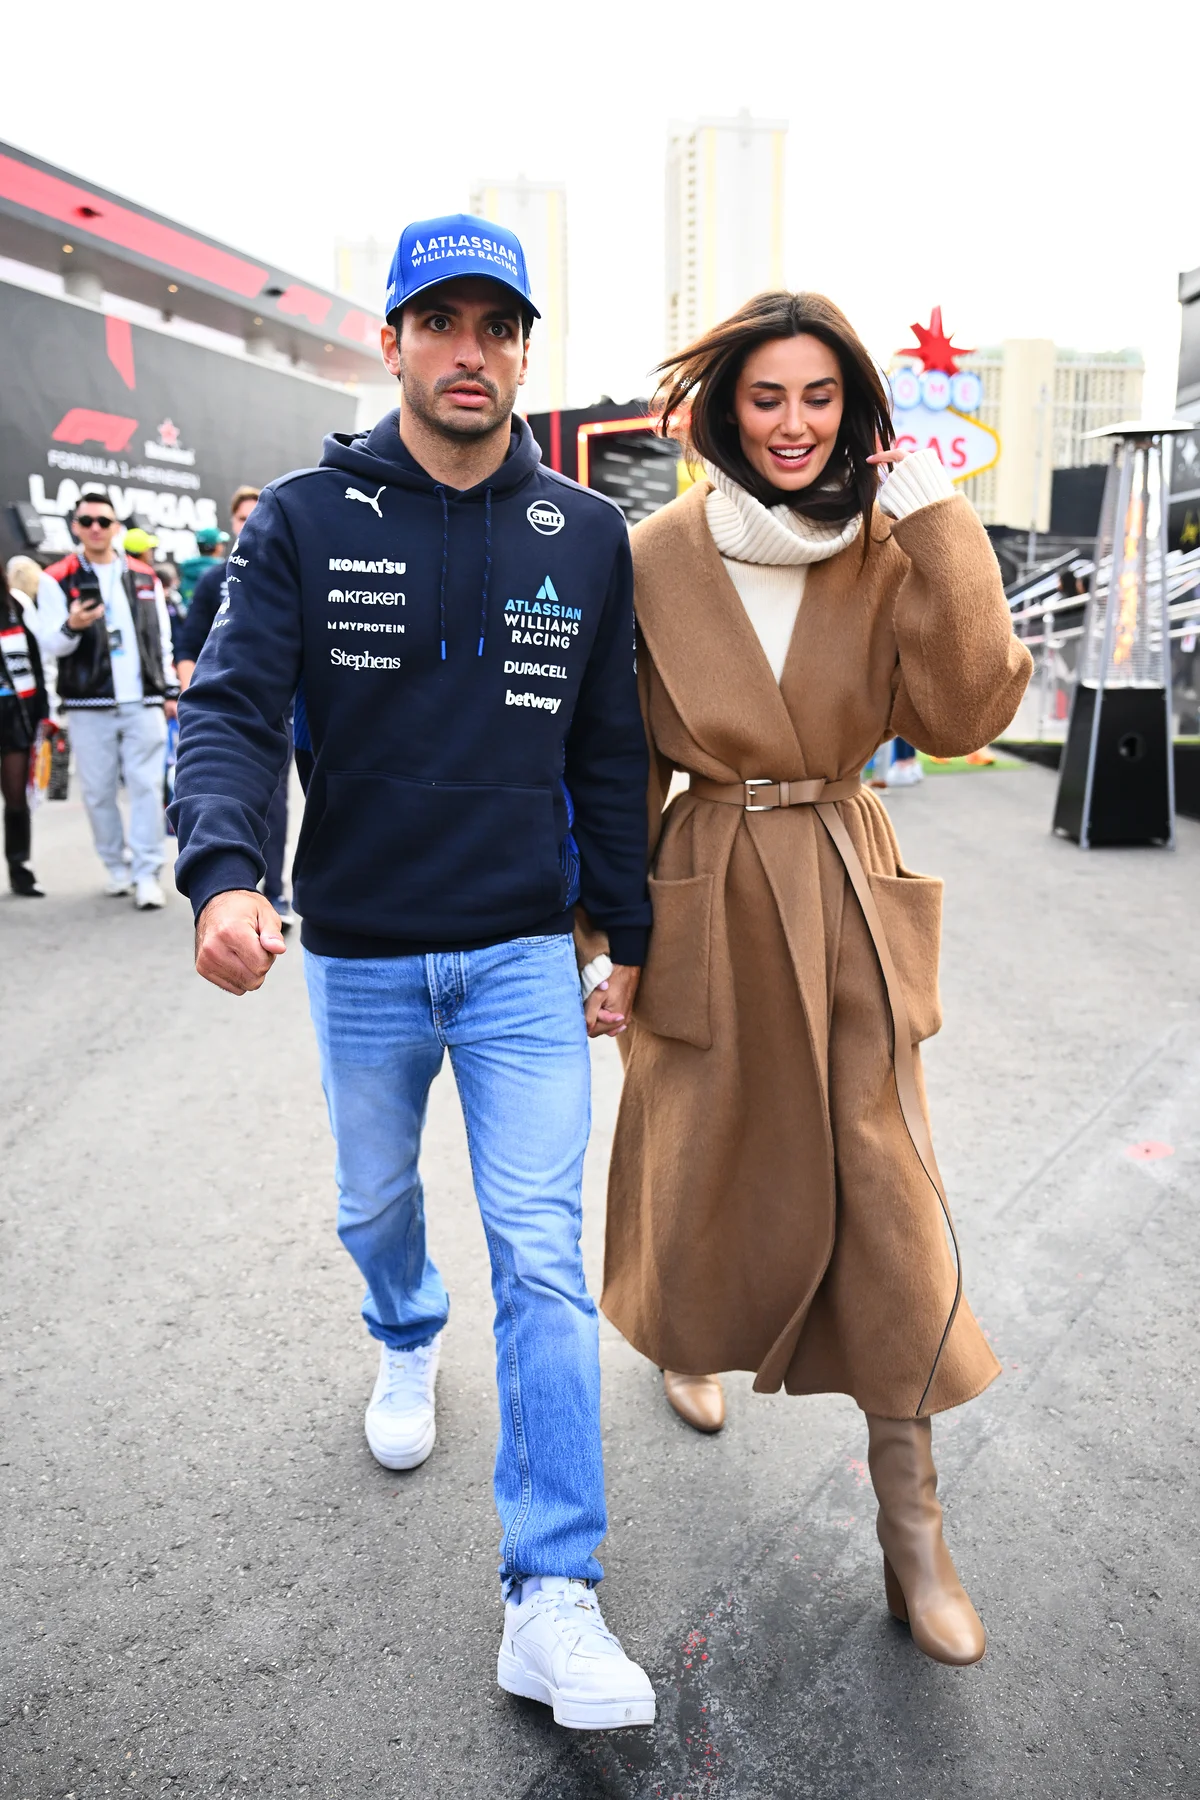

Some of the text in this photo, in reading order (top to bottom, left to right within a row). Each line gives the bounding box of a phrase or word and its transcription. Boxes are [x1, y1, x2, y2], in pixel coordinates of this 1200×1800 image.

[427, 235, 517, 264] ATLASSIAN
[411, 249, 518, 276] WILLIAMS RACING
[530, 510, 562, 525] Gulf
[329, 558, 406, 575] KOMATSU
[345, 589, 405, 606] kraken
[504, 599, 582, 621] ATLASSIAN
[339, 621, 405, 634] MYPROTEIN
[504, 613, 579, 636] WILLIAMS
[511, 629, 570, 650] RACING
[330, 648, 401, 671] Stephens
[503, 660, 567, 679] DURACELL
[505, 690, 561, 714] betway
